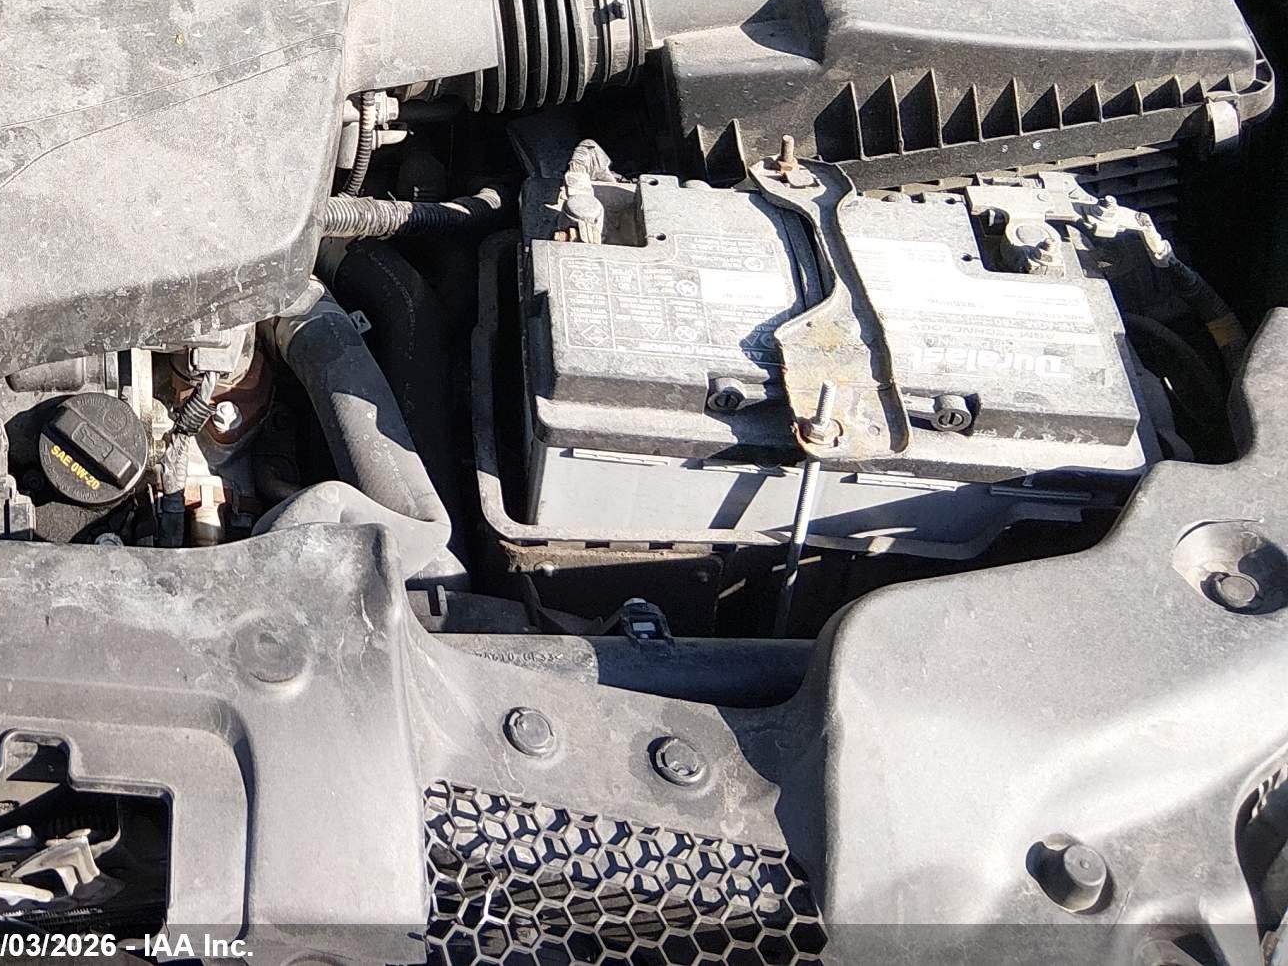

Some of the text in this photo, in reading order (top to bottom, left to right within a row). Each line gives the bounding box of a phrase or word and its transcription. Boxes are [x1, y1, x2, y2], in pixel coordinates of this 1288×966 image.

[912, 345, 1072, 379] Duralast
[50, 444, 73, 467] SAE
[70, 462, 101, 490] 0W-20
